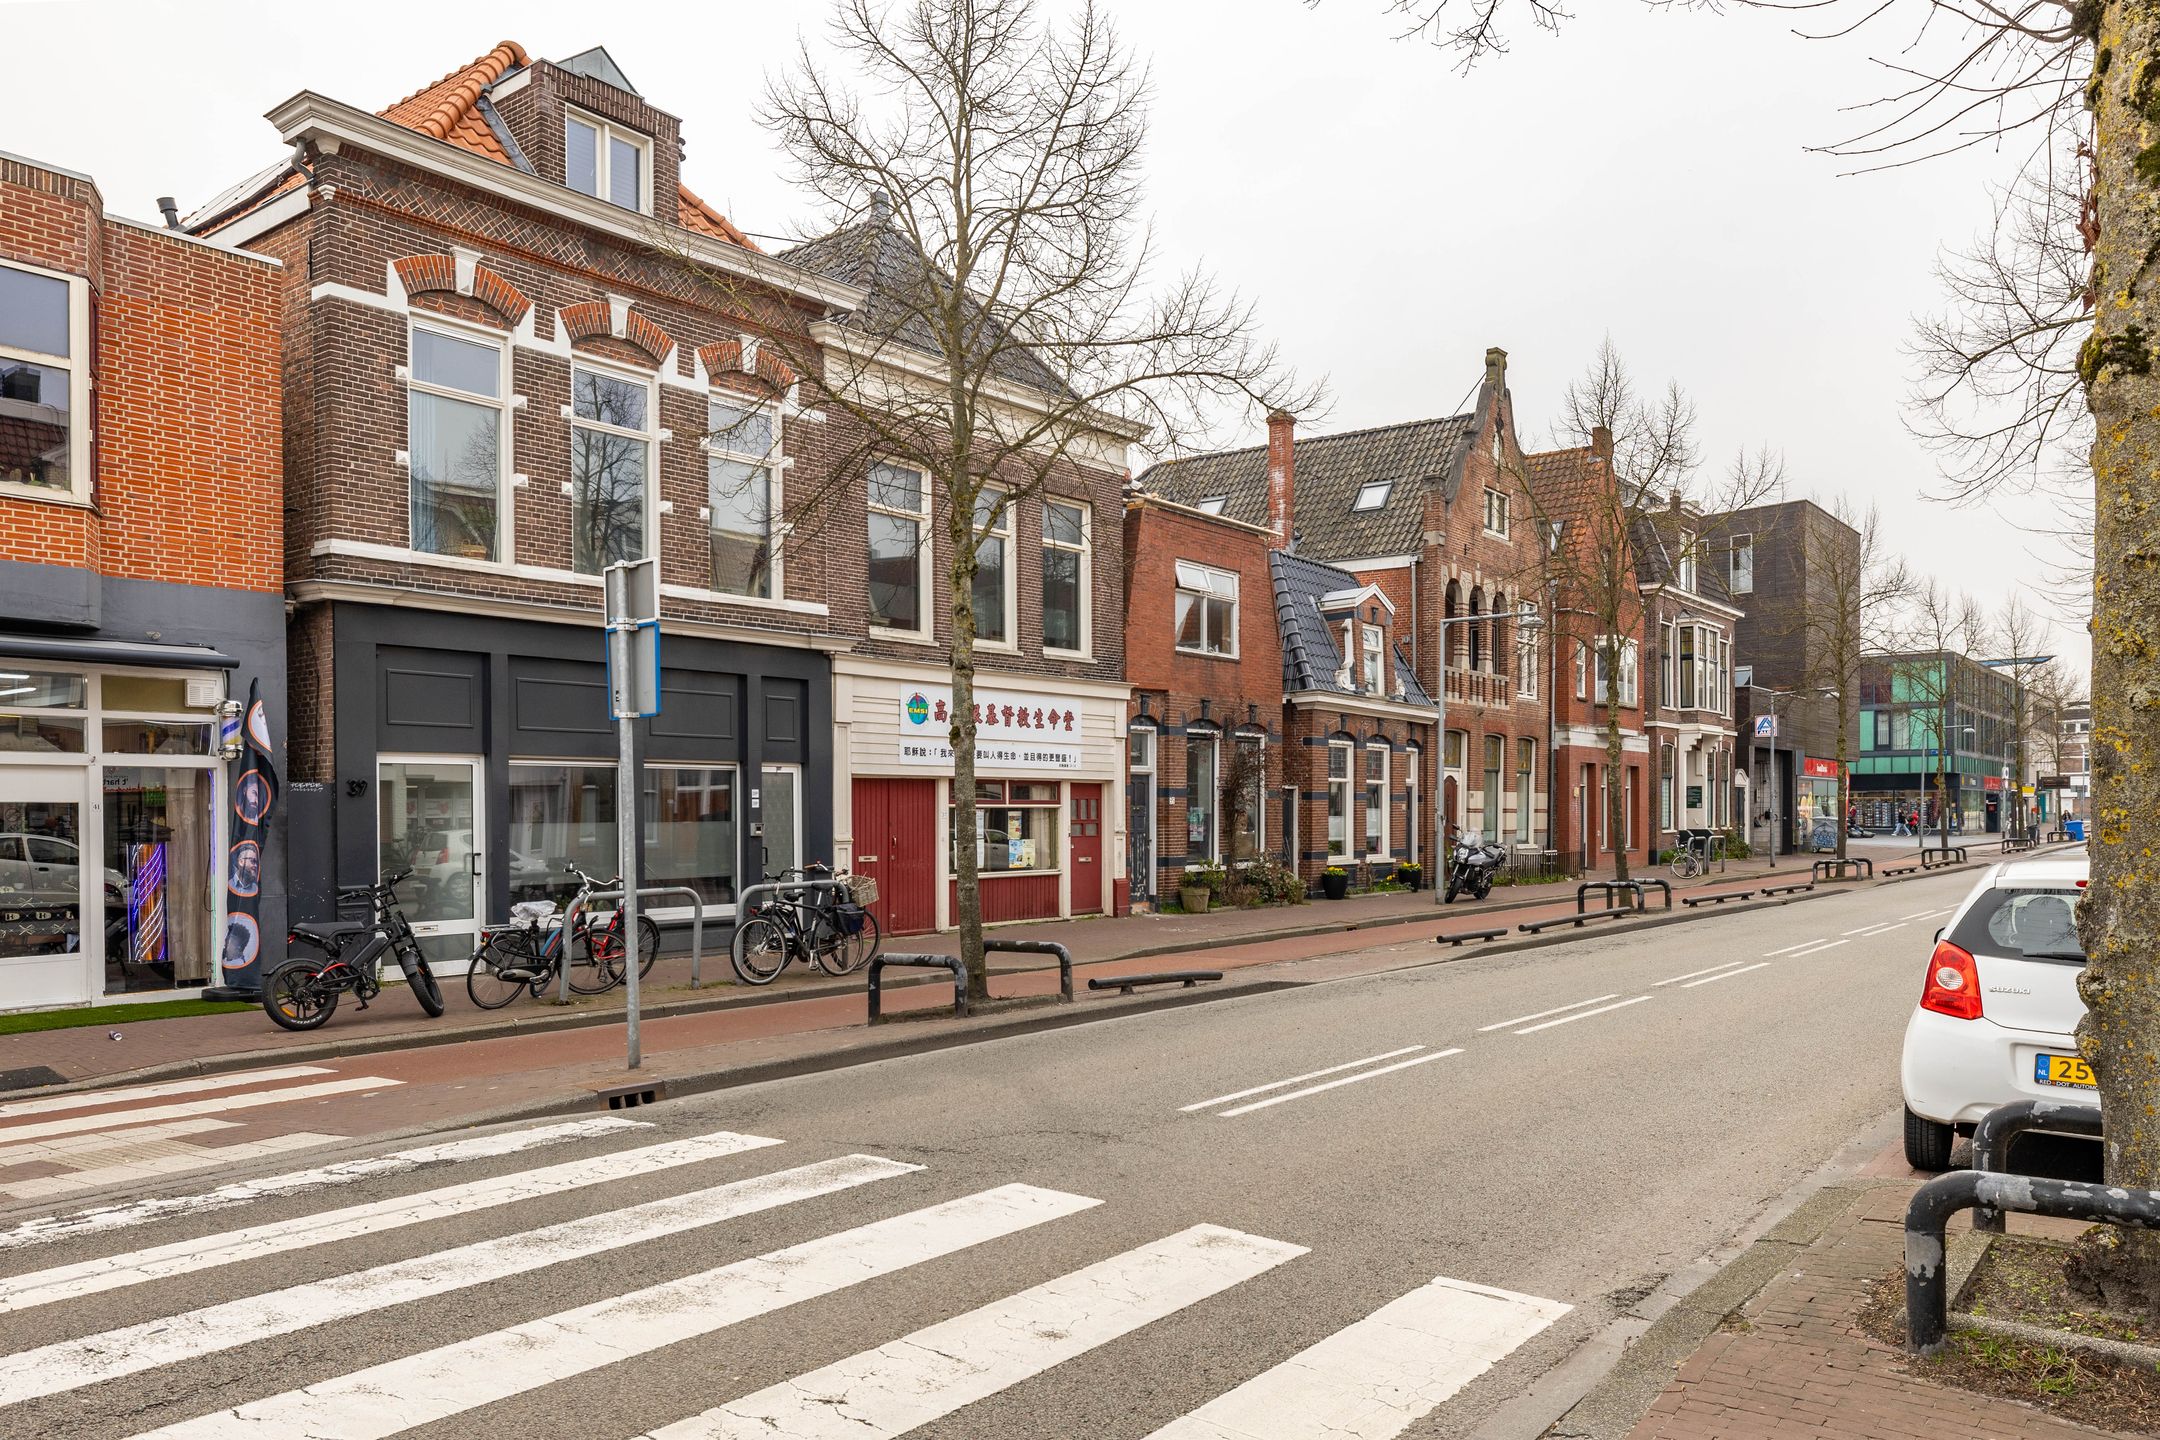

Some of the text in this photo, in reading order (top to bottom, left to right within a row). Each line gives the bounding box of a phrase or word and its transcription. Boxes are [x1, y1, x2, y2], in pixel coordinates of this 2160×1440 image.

[934, 699, 1075, 732] 高根基督教生命堂
[1989, 985, 2031, 994] SUZUKI
[2058, 1060, 2089, 1080] 25
